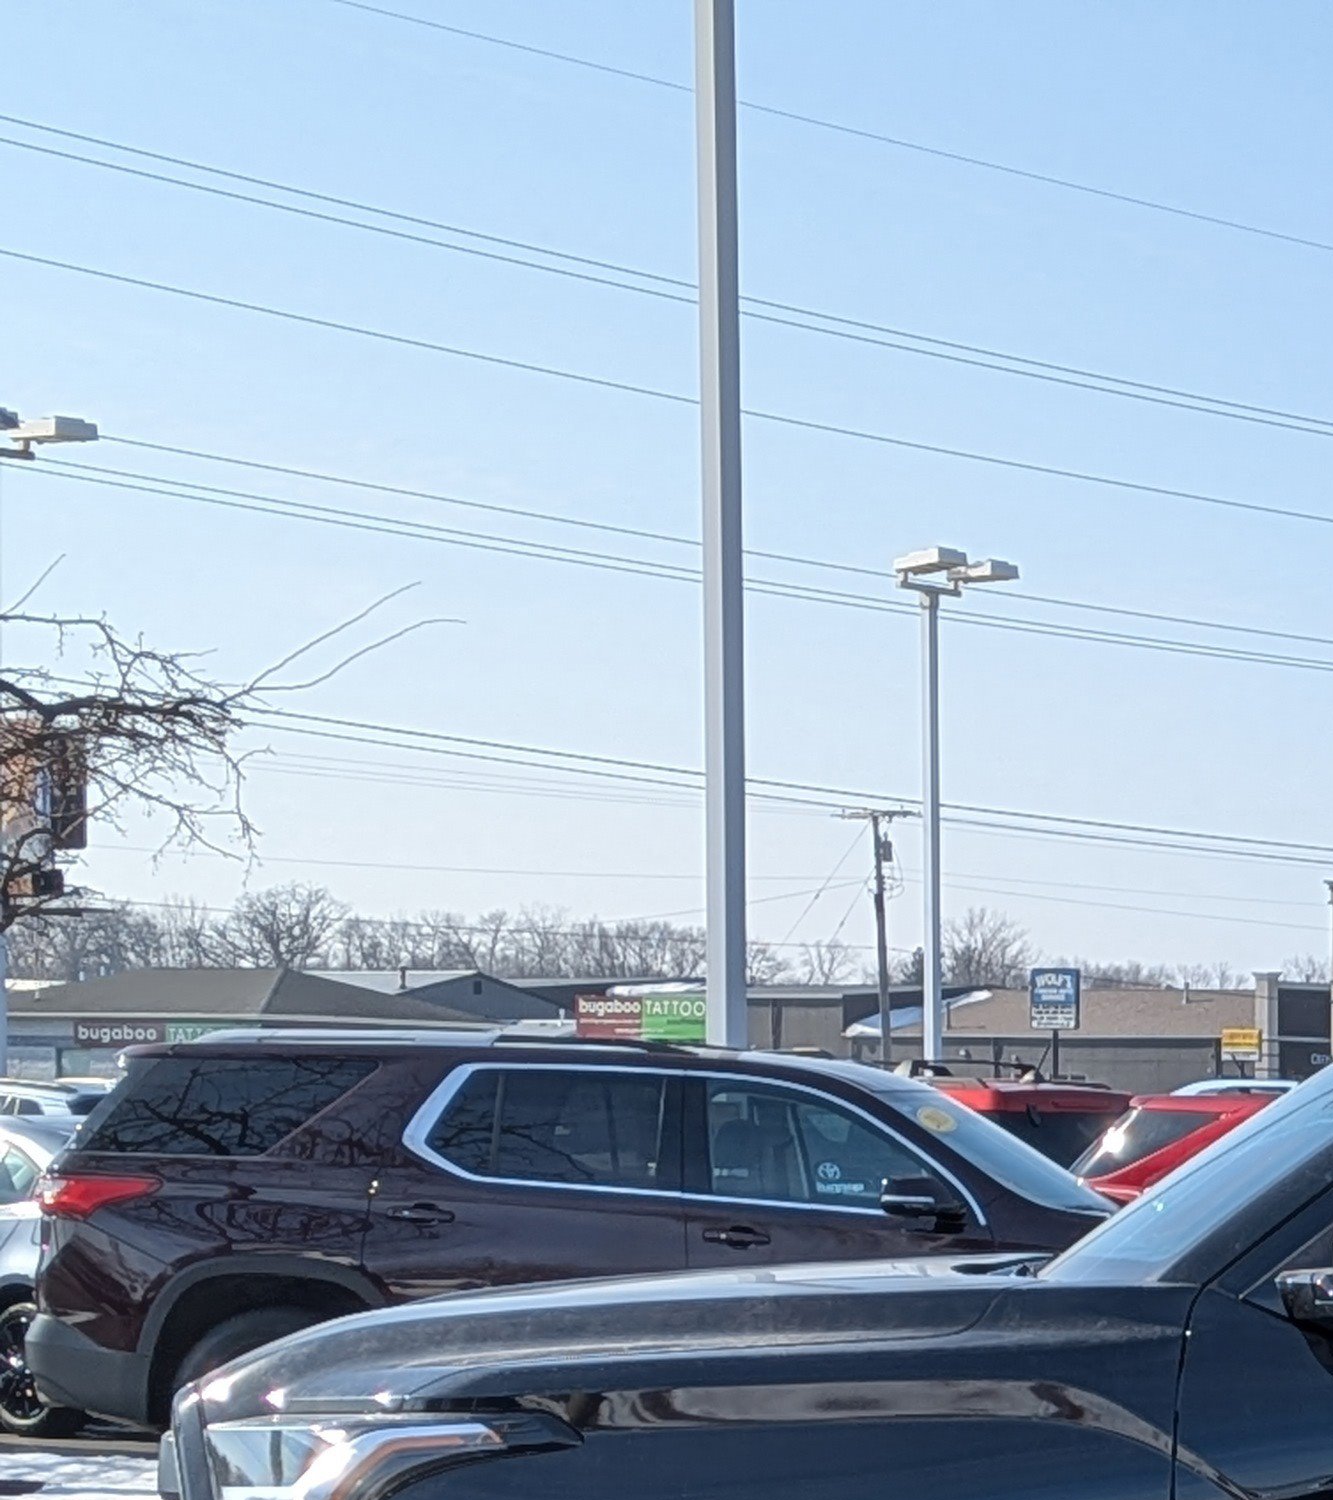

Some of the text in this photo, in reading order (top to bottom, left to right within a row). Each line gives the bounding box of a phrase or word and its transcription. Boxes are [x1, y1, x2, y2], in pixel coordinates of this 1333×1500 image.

[578, 997, 706, 1017] bugaboo TATTOO
[77, 1024, 158, 1044] bugaboo
